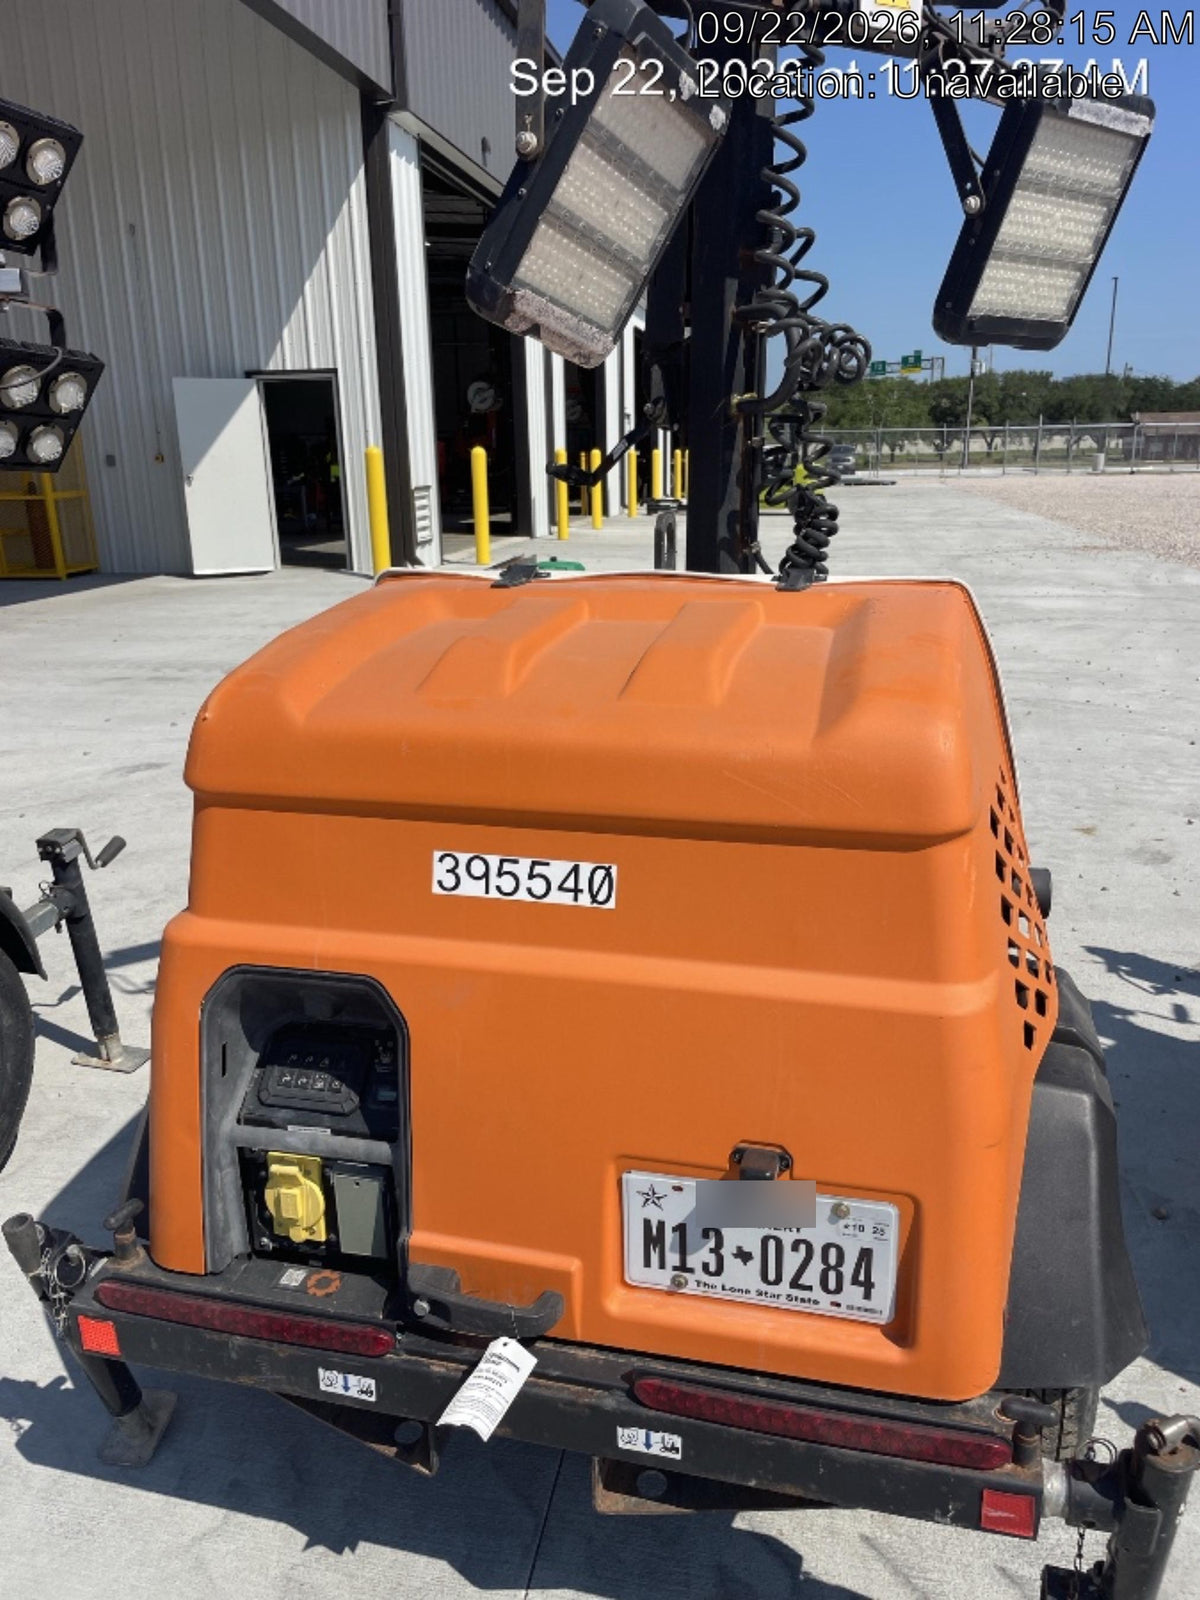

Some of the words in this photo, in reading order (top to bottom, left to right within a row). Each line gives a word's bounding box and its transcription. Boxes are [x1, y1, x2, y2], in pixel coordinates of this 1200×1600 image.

[436, 852, 615, 906] 395540
[642, 1217, 725, 1278] M13
[760, 1234, 876, 1302] 0284
[695, 1279, 718, 1290] The
[721, 1284, 751, 1296] Lone
[755, 1288, 783, 1300] Star
[785, 1294, 821, 1306] State
